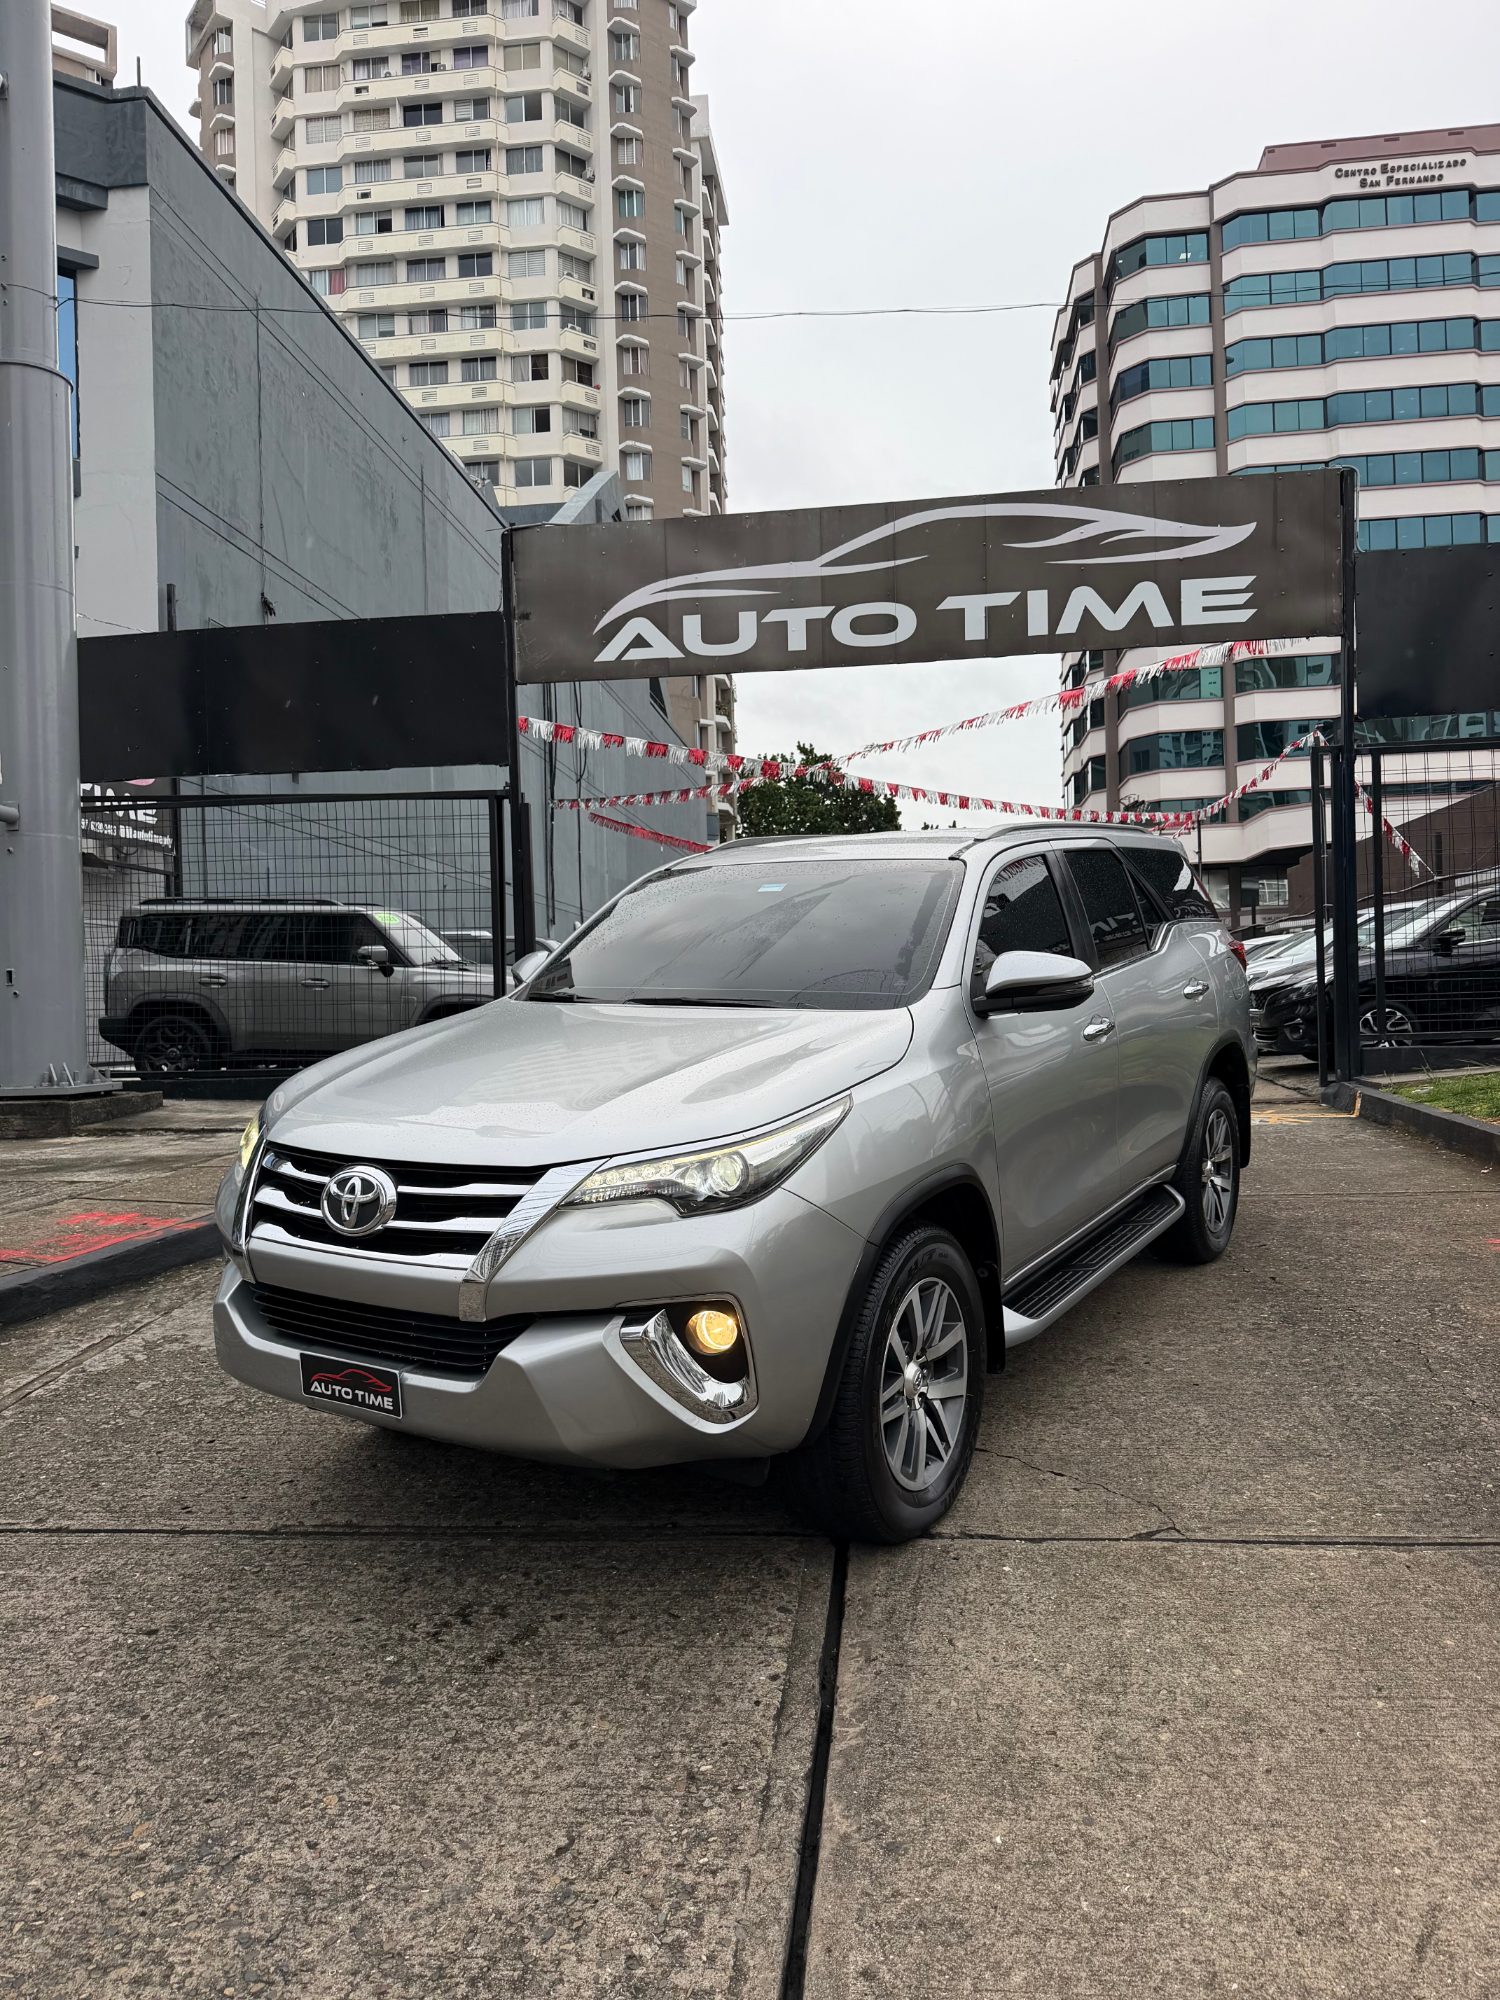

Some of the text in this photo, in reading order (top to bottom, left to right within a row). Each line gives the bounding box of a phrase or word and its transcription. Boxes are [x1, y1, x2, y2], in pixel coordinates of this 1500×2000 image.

[1335, 159, 1467, 178] CENTRO ESPECIALIZADO
[1359, 174, 1444, 188] SAN FERNANDO
[593, 576, 1258, 663] AUTO TIME
[310, 1381, 395, 1410] AUTO TIME
